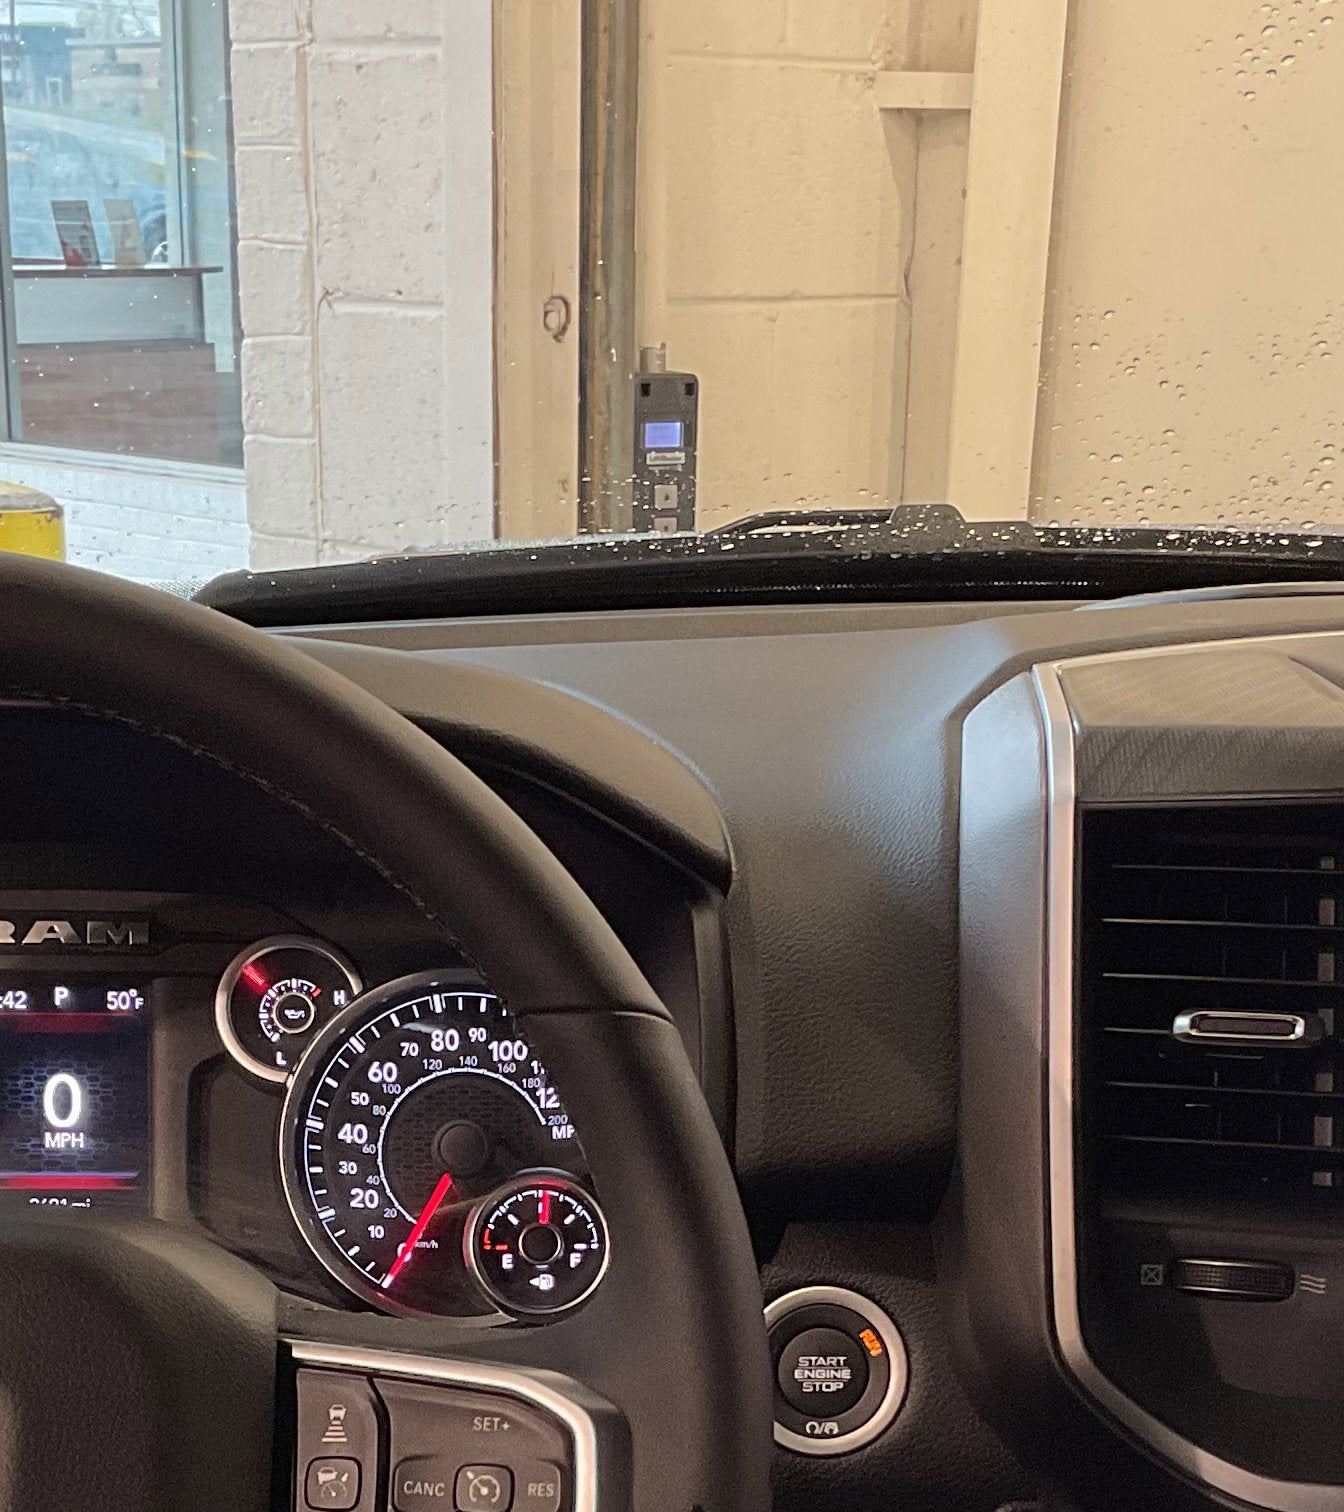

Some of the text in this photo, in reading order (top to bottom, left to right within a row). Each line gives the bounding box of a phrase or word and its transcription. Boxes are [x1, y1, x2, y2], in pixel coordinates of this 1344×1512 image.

[54, 986, 68, 1006] P
[333, 989, 345, 1005] H
[430, 1028, 460, 1052] 80
[468, 1027, 487, 1042] 90
[399, 1041, 419, 1057] 70
[487, 1040, 528, 1062] 100
[276, 1051, 286, 1065] L
[422, 1059, 442, 1071] 120
[459, 1056, 478, 1067] 140
[367, 1062, 398, 1083] 60
[497, 1062, 516, 1074] 160
[382, 1083, 401, 1095] 100
[521, 1077, 541, 1089] 180
[43, 1073, 81, 1128] 0
[350, 1092, 370, 1106] 50
[535, 1087, 560, 1109] 12
[372, 1105, 386, 1116] 80
[547, 1114, 568, 1126] 200
[44, 1131, 85, 1148] MPH
[337, 1123, 368, 1144] 40
[552, 1125, 576, 1140] MP
[362, 1144, 376, 1154] 60
[338, 1161, 357, 1175] 30
[366, 1175, 380, 1185] 40
[349, 1188, 379, 1209] 20
[383, 1208, 397, 1218] 20
[367, 1225, 385, 1239] 10
[502, 1253, 513, 1269] E
[569, 1252, 582, 1268] F
[798, 1356, 847, 1367] START
[793, 1369, 851, 1380] ENGINE
[802, 1381, 844, 1393] STOP
[403, 1480, 445, 1498] CANC
[527, 1482, 554, 1498] RES
